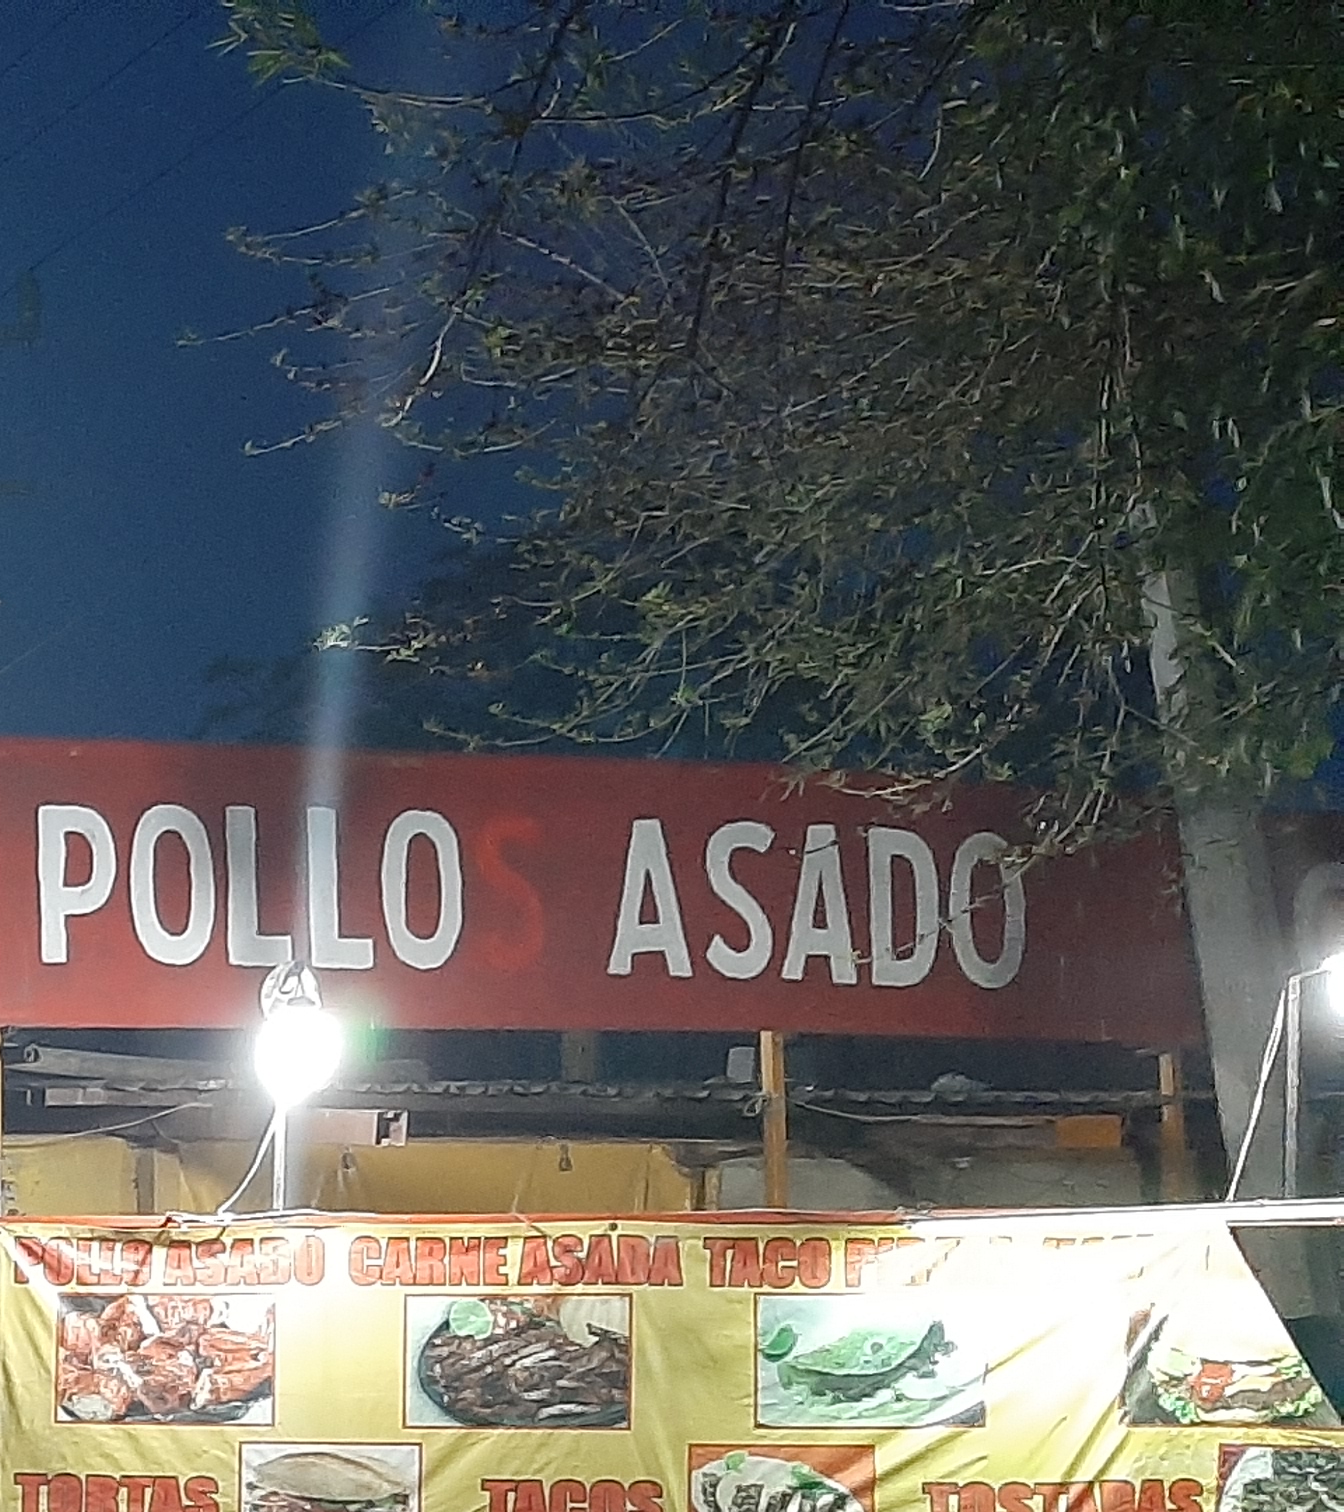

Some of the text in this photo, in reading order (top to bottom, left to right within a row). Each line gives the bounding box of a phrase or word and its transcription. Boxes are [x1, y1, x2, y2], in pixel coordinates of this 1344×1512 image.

[606, 817, 1027, 989] ASADO
[13, 1236, 152, 1287] POLLO
[162, 1235, 325, 1287] ASADO
[349, 1236, 507, 1287] CARNE
[519, 1235, 683, 1287] ASADA
[703, 1236, 832, 1289] TACO
